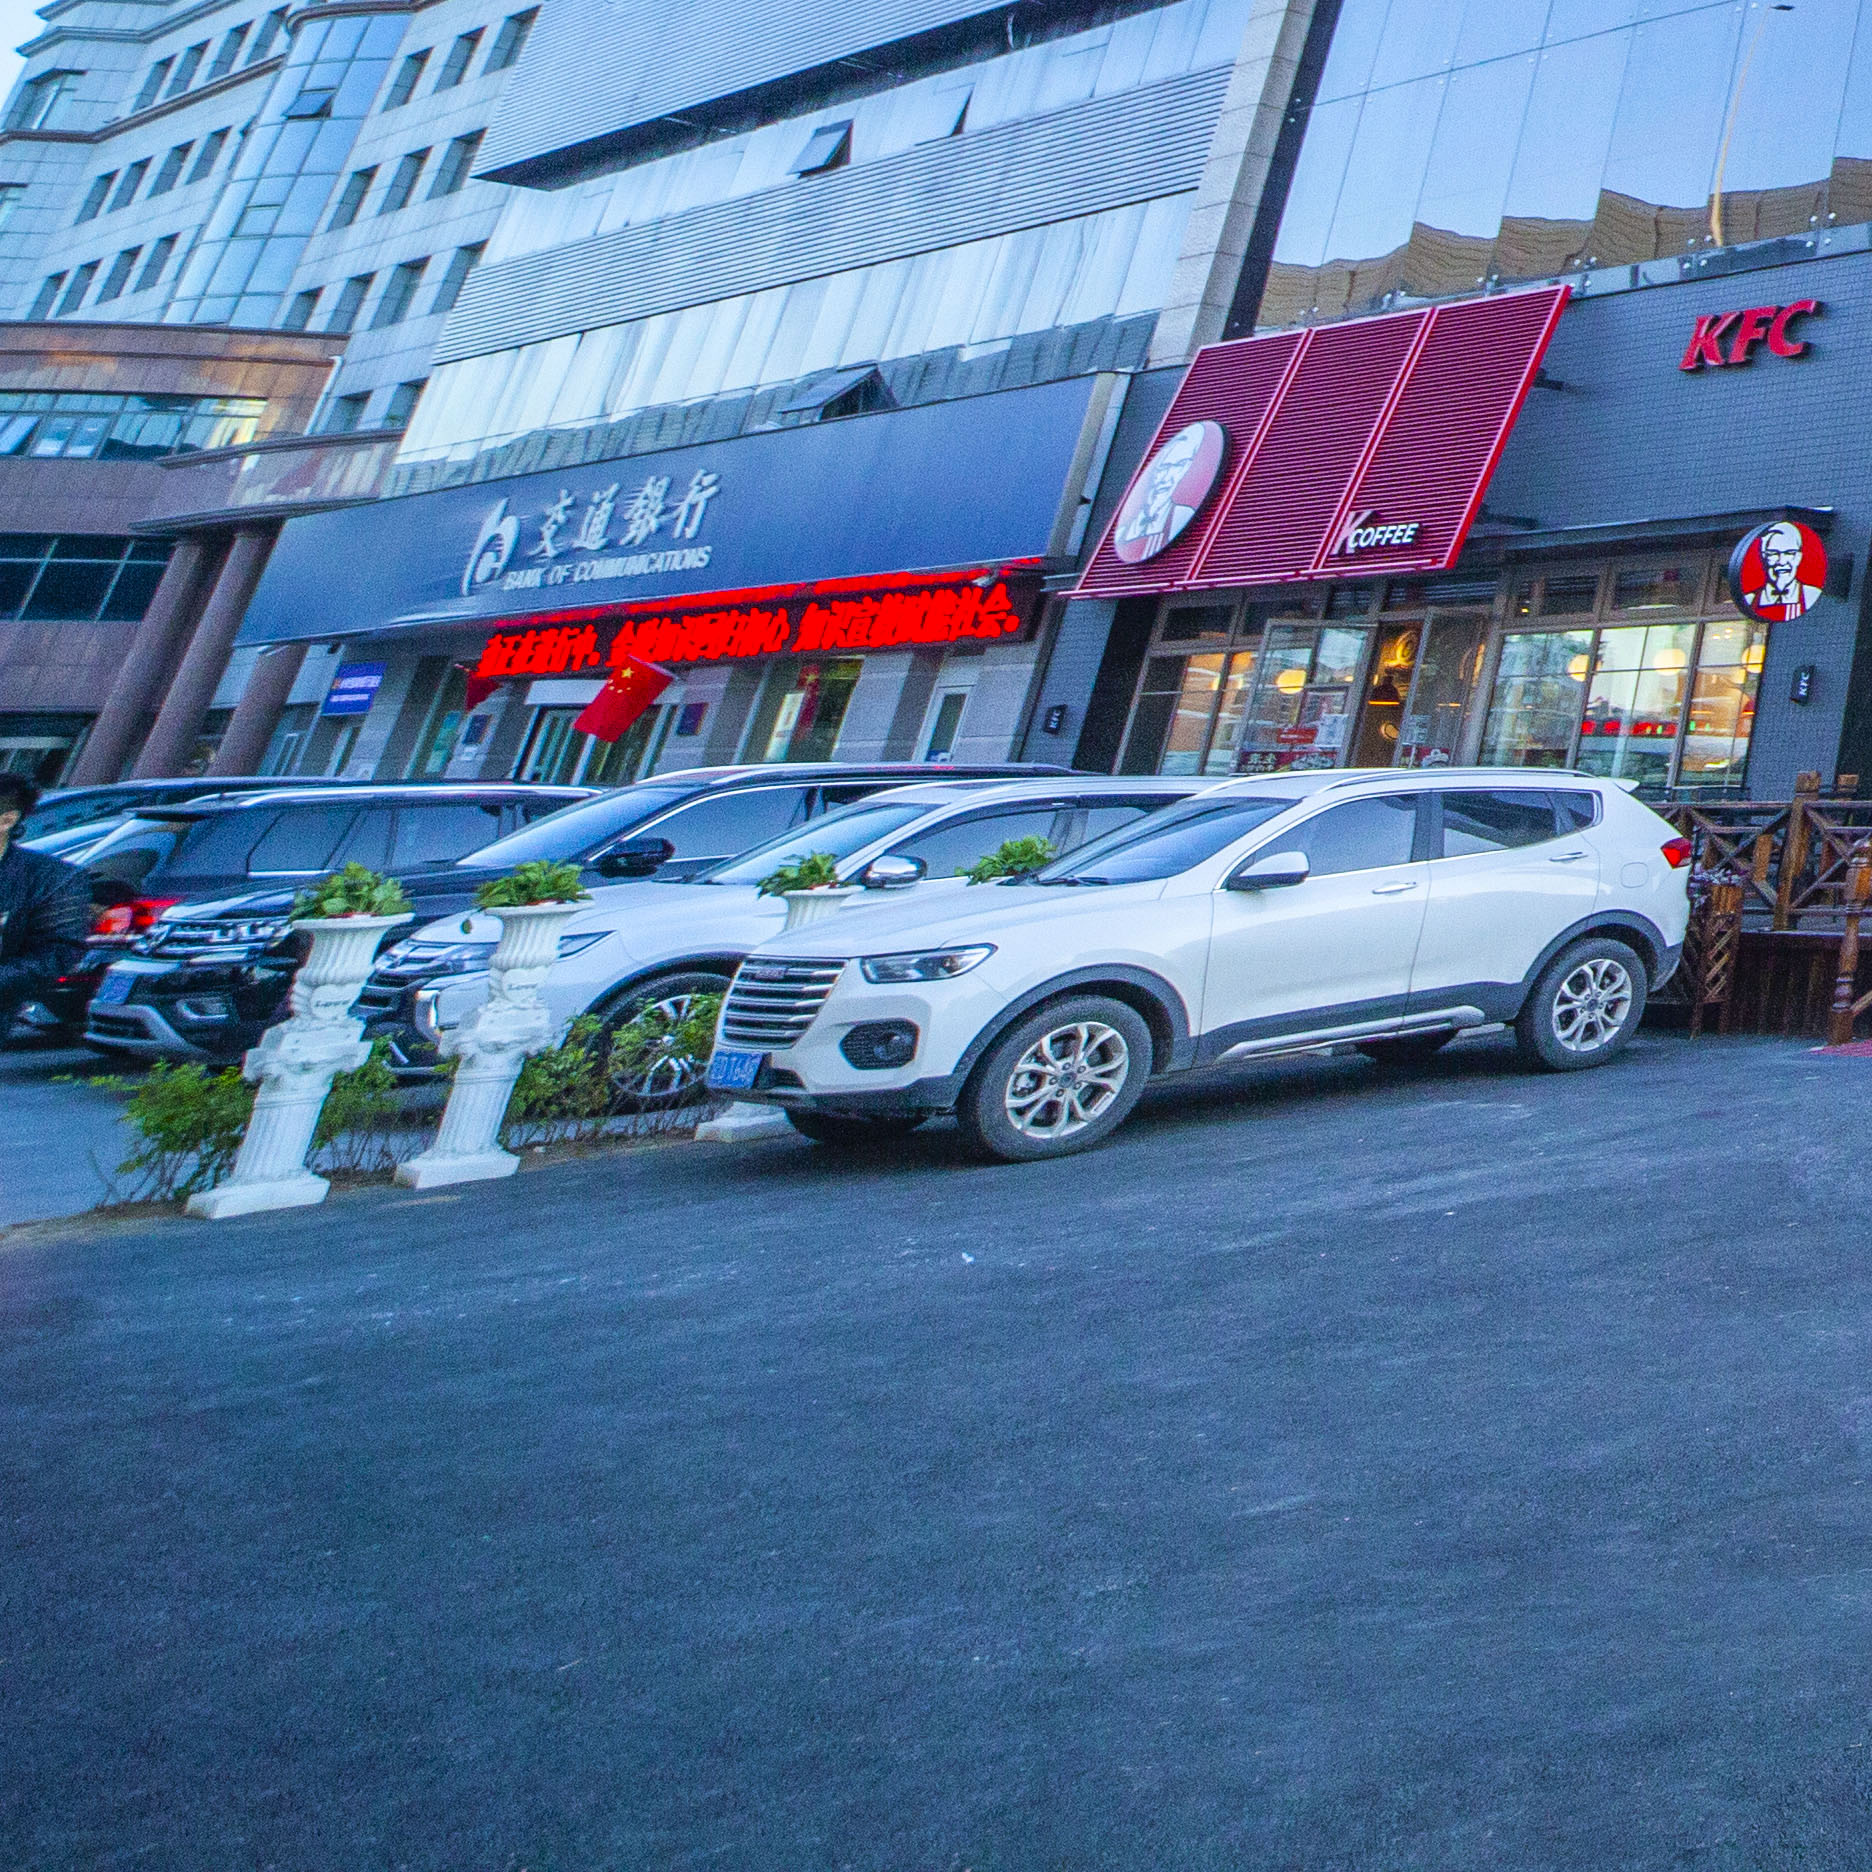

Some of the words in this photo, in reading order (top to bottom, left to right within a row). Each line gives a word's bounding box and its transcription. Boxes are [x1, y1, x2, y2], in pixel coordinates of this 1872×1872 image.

[1678, 299, 1818, 371] KFC
[503, 567, 548, 590] BANK
[550, 562, 574, 585] OF
[573, 546, 712, 582] COMMUNICATIONS
